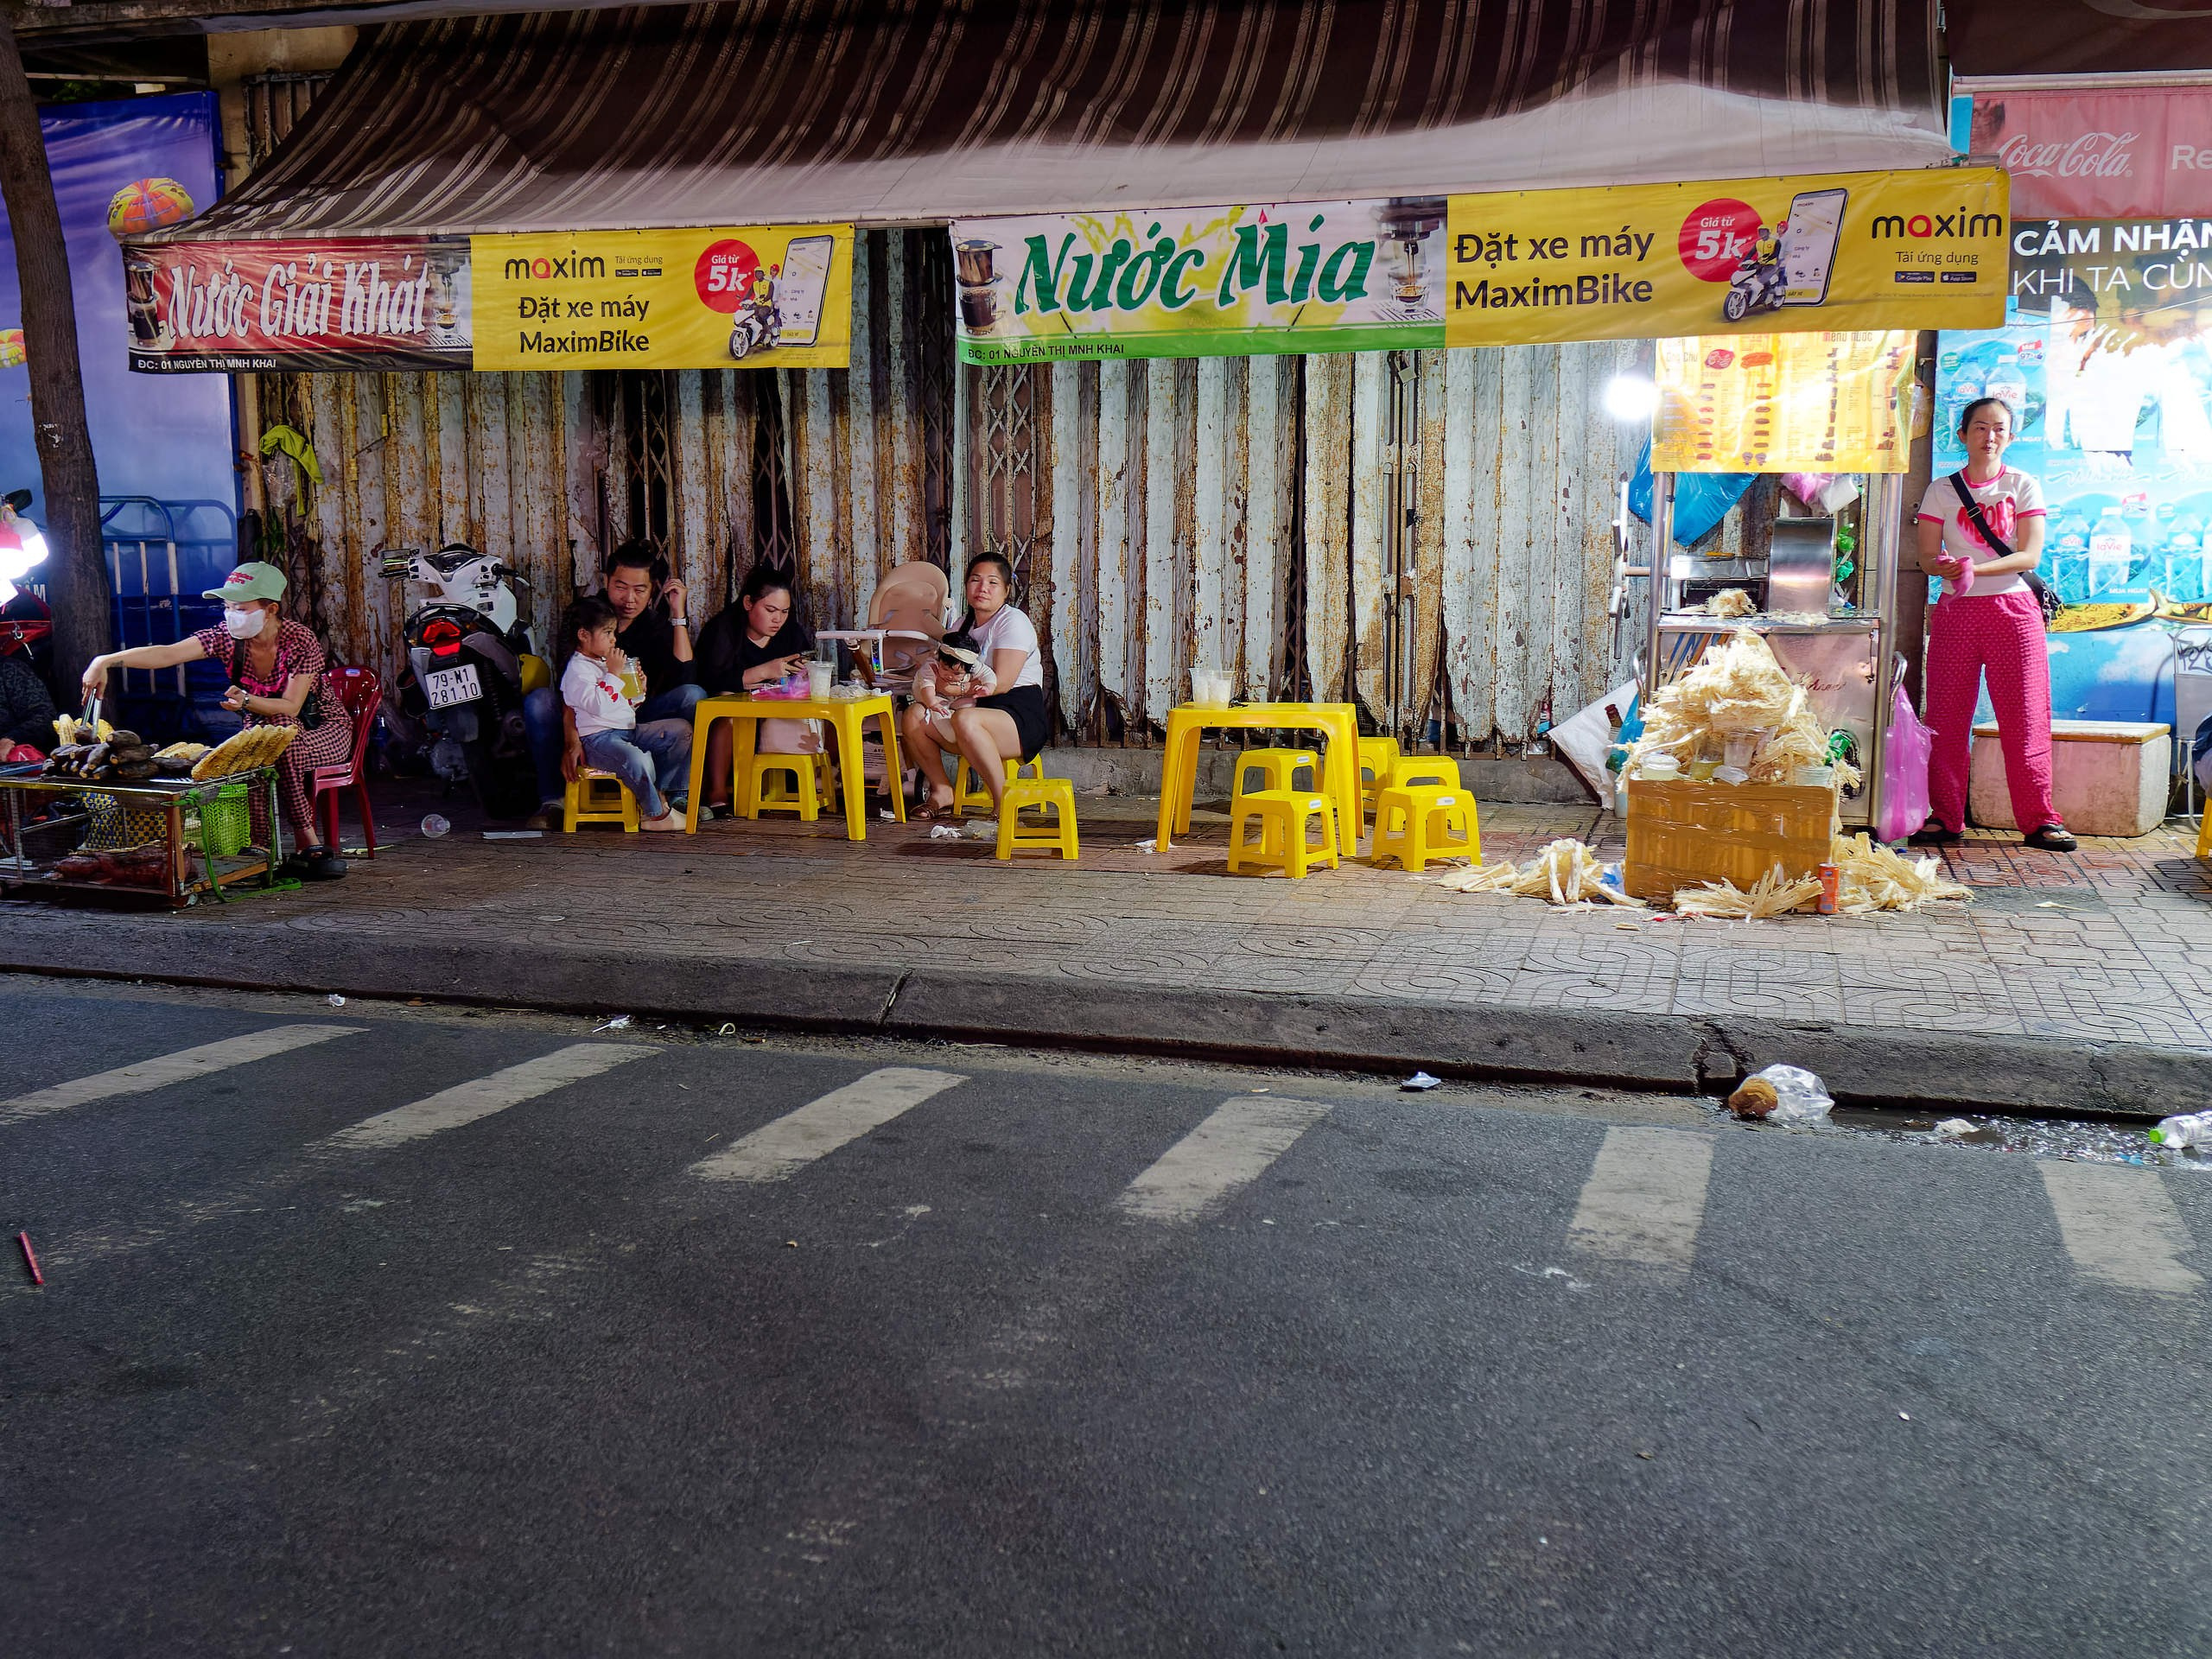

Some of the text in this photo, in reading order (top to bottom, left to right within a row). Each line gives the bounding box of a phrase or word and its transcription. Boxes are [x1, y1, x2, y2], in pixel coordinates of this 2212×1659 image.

[1998, 132, 2141, 178] Coca-Cola
[1700, 217, 1719, 227] Giá
[1872, 206, 2001, 238] maxim
[1454, 225, 1655, 269] Đặt xe máy
[2013, 220, 2100, 256] CẢM
[505, 250, 605, 279] maxim
[711, 255, 726, 264] Giá
[1014, 214, 1376, 315] Nước Mía
[1895, 251, 1979, 265] Tải ứng dụng
[1455, 273, 1652, 309] MaximBike
[2013, 269, 2074, 296] KHI
[2086, 266, 2131, 293] TA
[169, 253, 430, 338] Nước Giải Khát
[518, 295, 650, 323] Đặt xe máy
[520, 329, 650, 353] MaximBike
[989, 350, 1000, 359] 01
[1048, 346, 1065, 357] THỊ
[1096, 344, 1124, 353] KHAI
[162, 359, 172, 369] 01
[208, 359, 226, 370] THỊ
[252, 359, 276, 368] KHAI
[433, 669, 469, 690] 79-N1
[431, 683, 479, 706] 281.10
